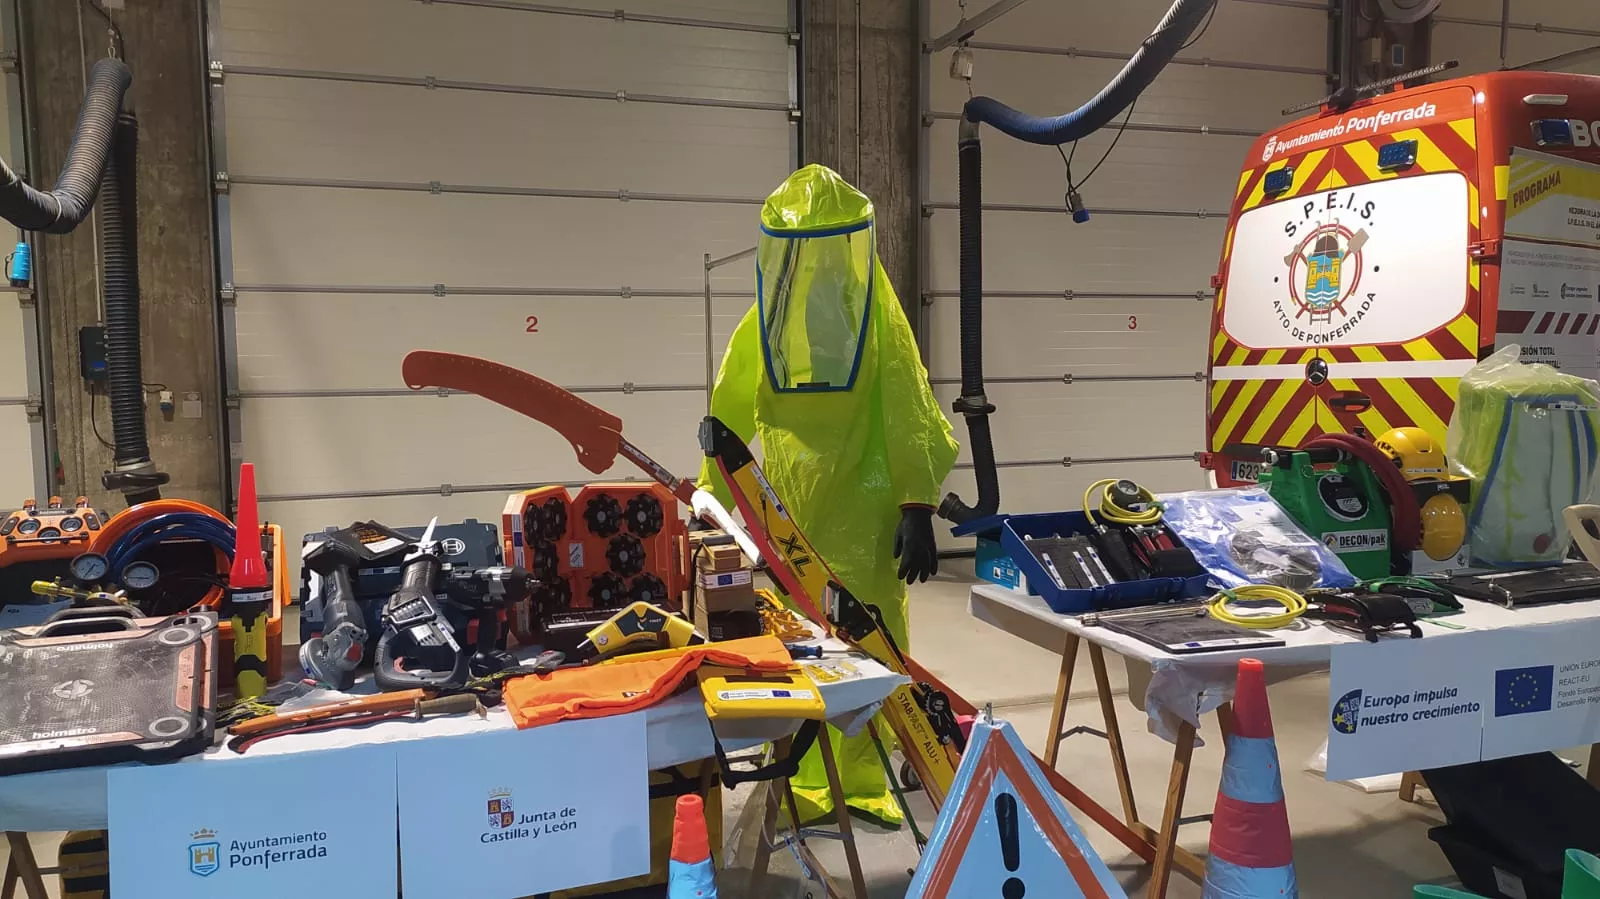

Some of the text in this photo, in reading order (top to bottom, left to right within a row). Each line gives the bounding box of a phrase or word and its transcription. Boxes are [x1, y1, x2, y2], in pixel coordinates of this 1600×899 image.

[1275, 101, 1437, 154] Ayuntamiento Ponferrada
[1513, 170, 1561, 208] PROGRAMA
[1284, 191, 1376, 237] S.P.E.I.S.
[526, 316, 538, 332] 2
[1128, 315, 1137, 330] 3
[1273, 292, 1376, 344] AYTO. DE PONFERRADA
[1339, 533, 1386, 547] DECON/pak
[774, 531, 812, 577] XL
[1364, 686, 1458, 709] Europa impulsa
[1361, 701, 1480, 726] nuestro crecimiento
[32, 727, 97, 740] holmatro
[518, 807, 577, 825] Junta de
[230, 831, 327, 853] Ayuntamiento
[480, 820, 577, 843] Castilla y León
[229, 844, 328, 869] Ponferrada
